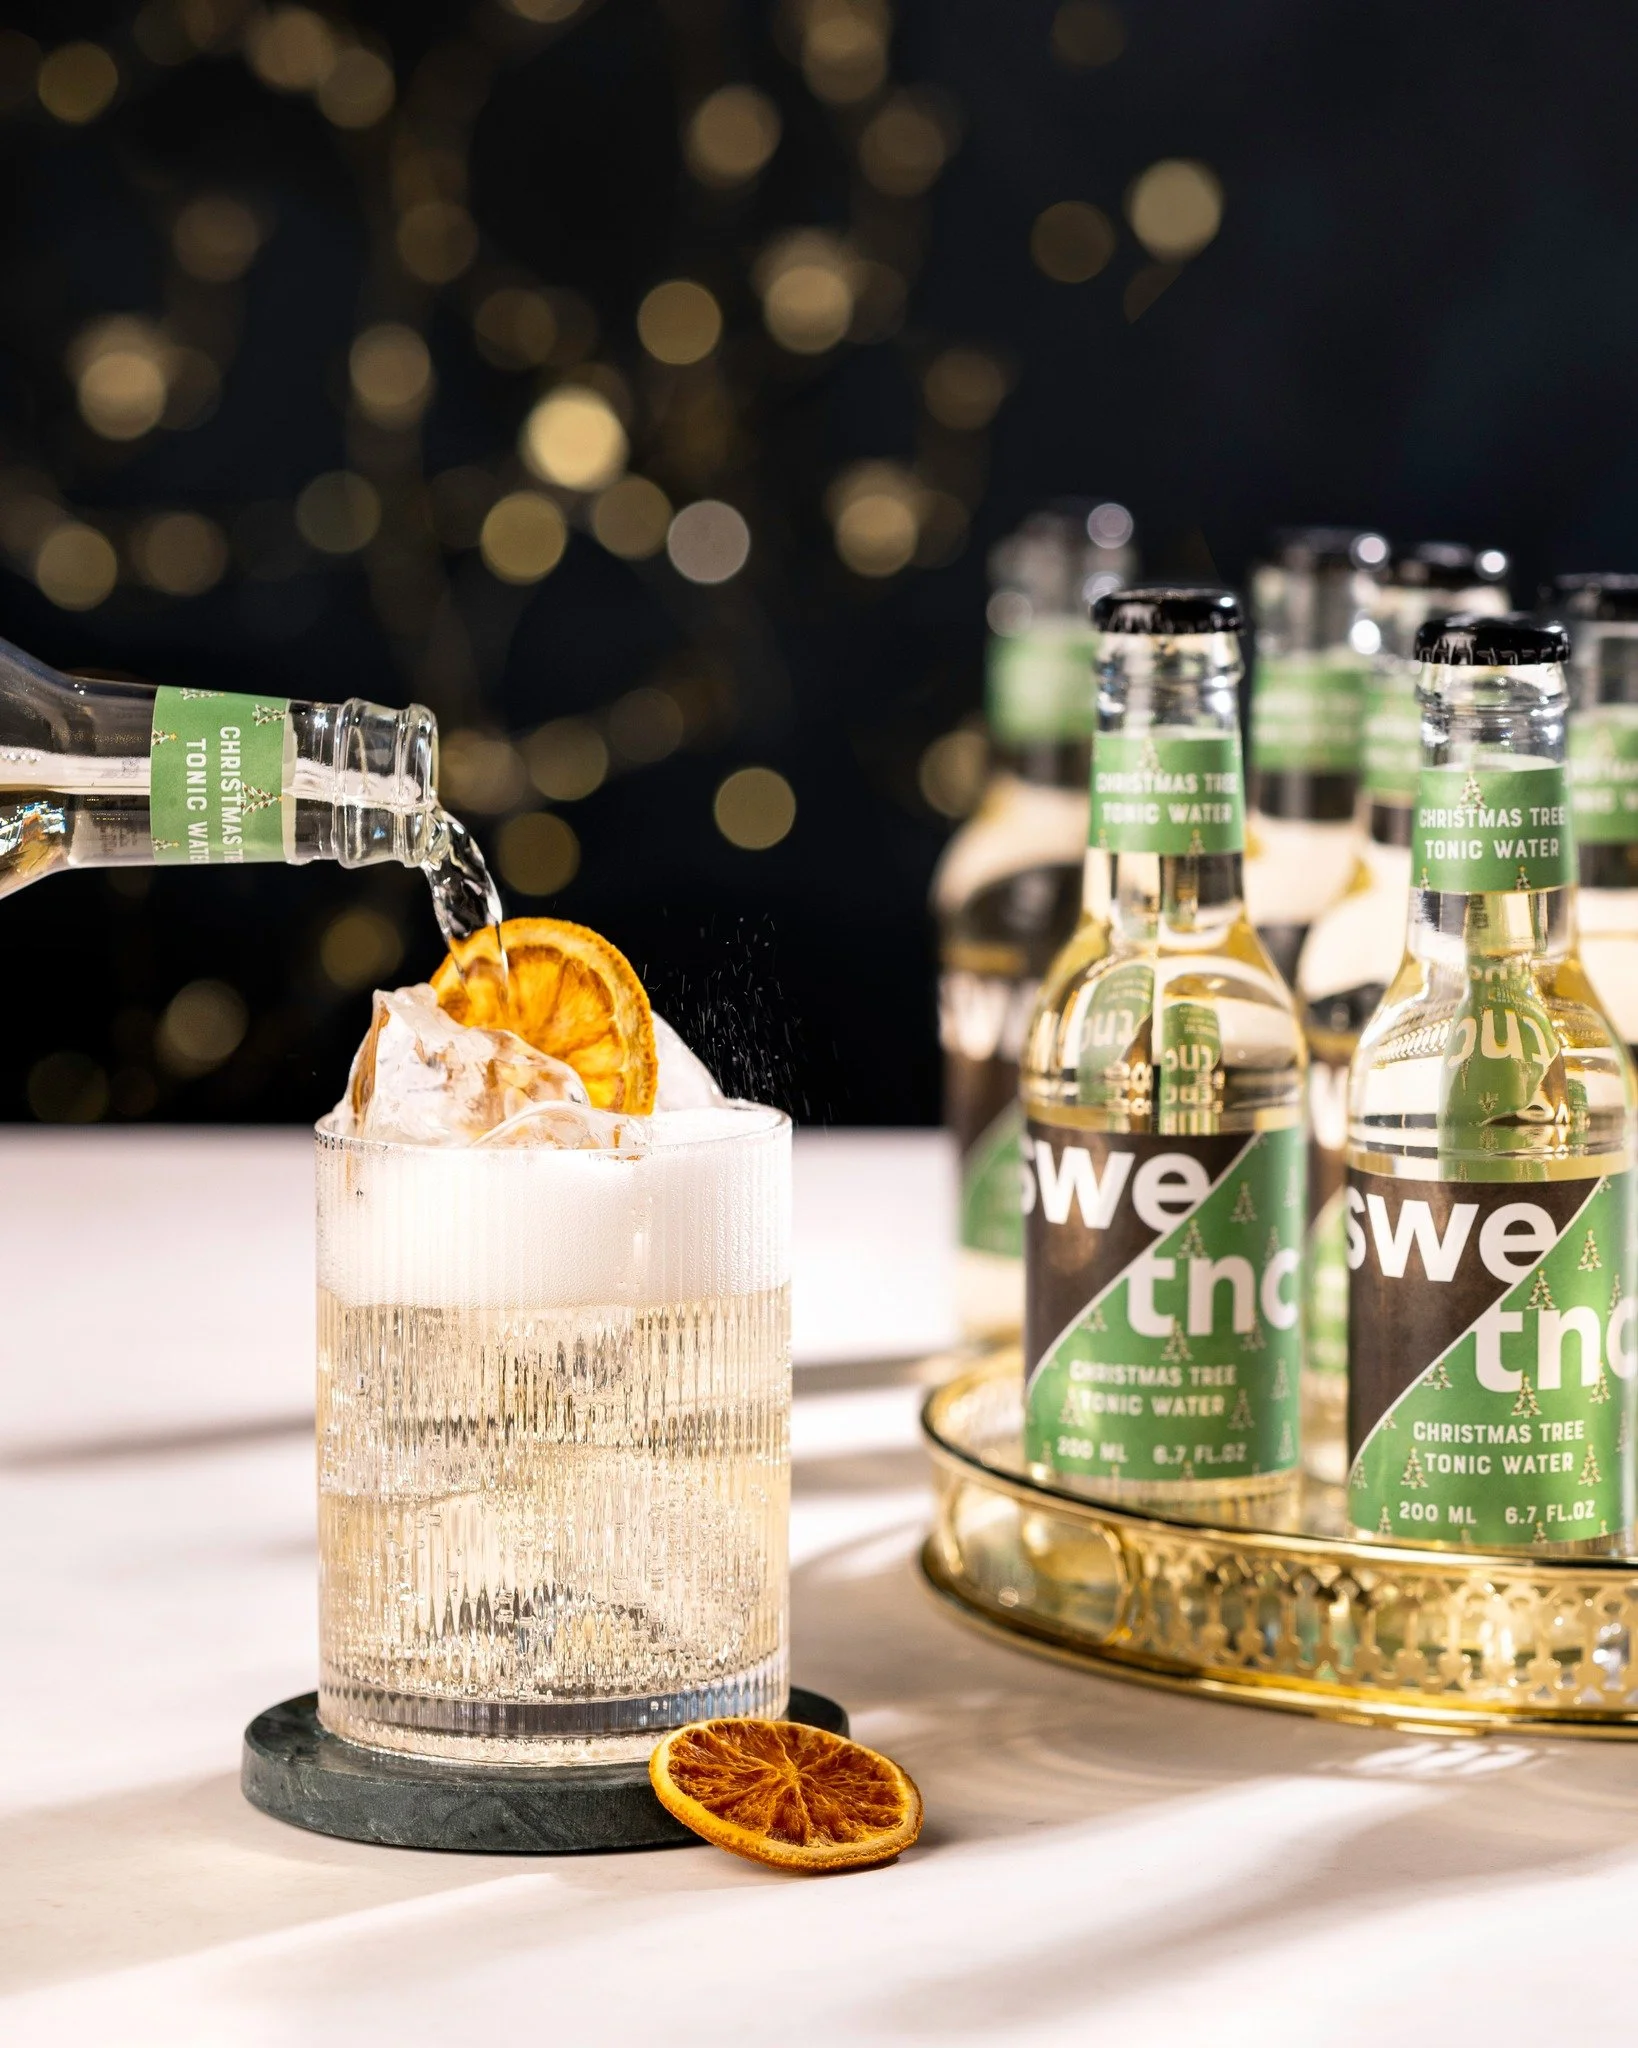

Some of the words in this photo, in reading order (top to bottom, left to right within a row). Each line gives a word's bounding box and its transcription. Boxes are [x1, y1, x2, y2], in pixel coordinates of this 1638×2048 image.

[186, 738, 208, 811] TONIC
[220, 726, 243, 846] CHRISTMAS
[1168, 803, 1232, 824] WATER
[1419, 808, 1523, 828] CHRISTMAS
[1529, 806, 1567, 826] TREE
[1425, 839, 1483, 860] TONIC
[1494, 838, 1559, 860] WATER
[1346, 1185, 1559, 1285] swe
[1069, 1360, 1183, 1387] CHRISTMAS
[1190, 1364, 1237, 1386] TREE
[1080, 1390, 1143, 1416] TONIC
[1151, 1394, 1225, 1417] WATER
[1413, 1420, 1532, 1444] CHRISTMAS
[1539, 1420, 1585, 1443] TREE
[1424, 1452, 1492, 1475] TONIC
[1502, 1452, 1574, 1475] WATER
[1399, 1501, 1439, 1522] 200
[1448, 1505, 1477, 1525] ML
[1505, 1506, 1537, 1525] 6.7
[1546, 1499, 1596, 1523] FL.OZ
